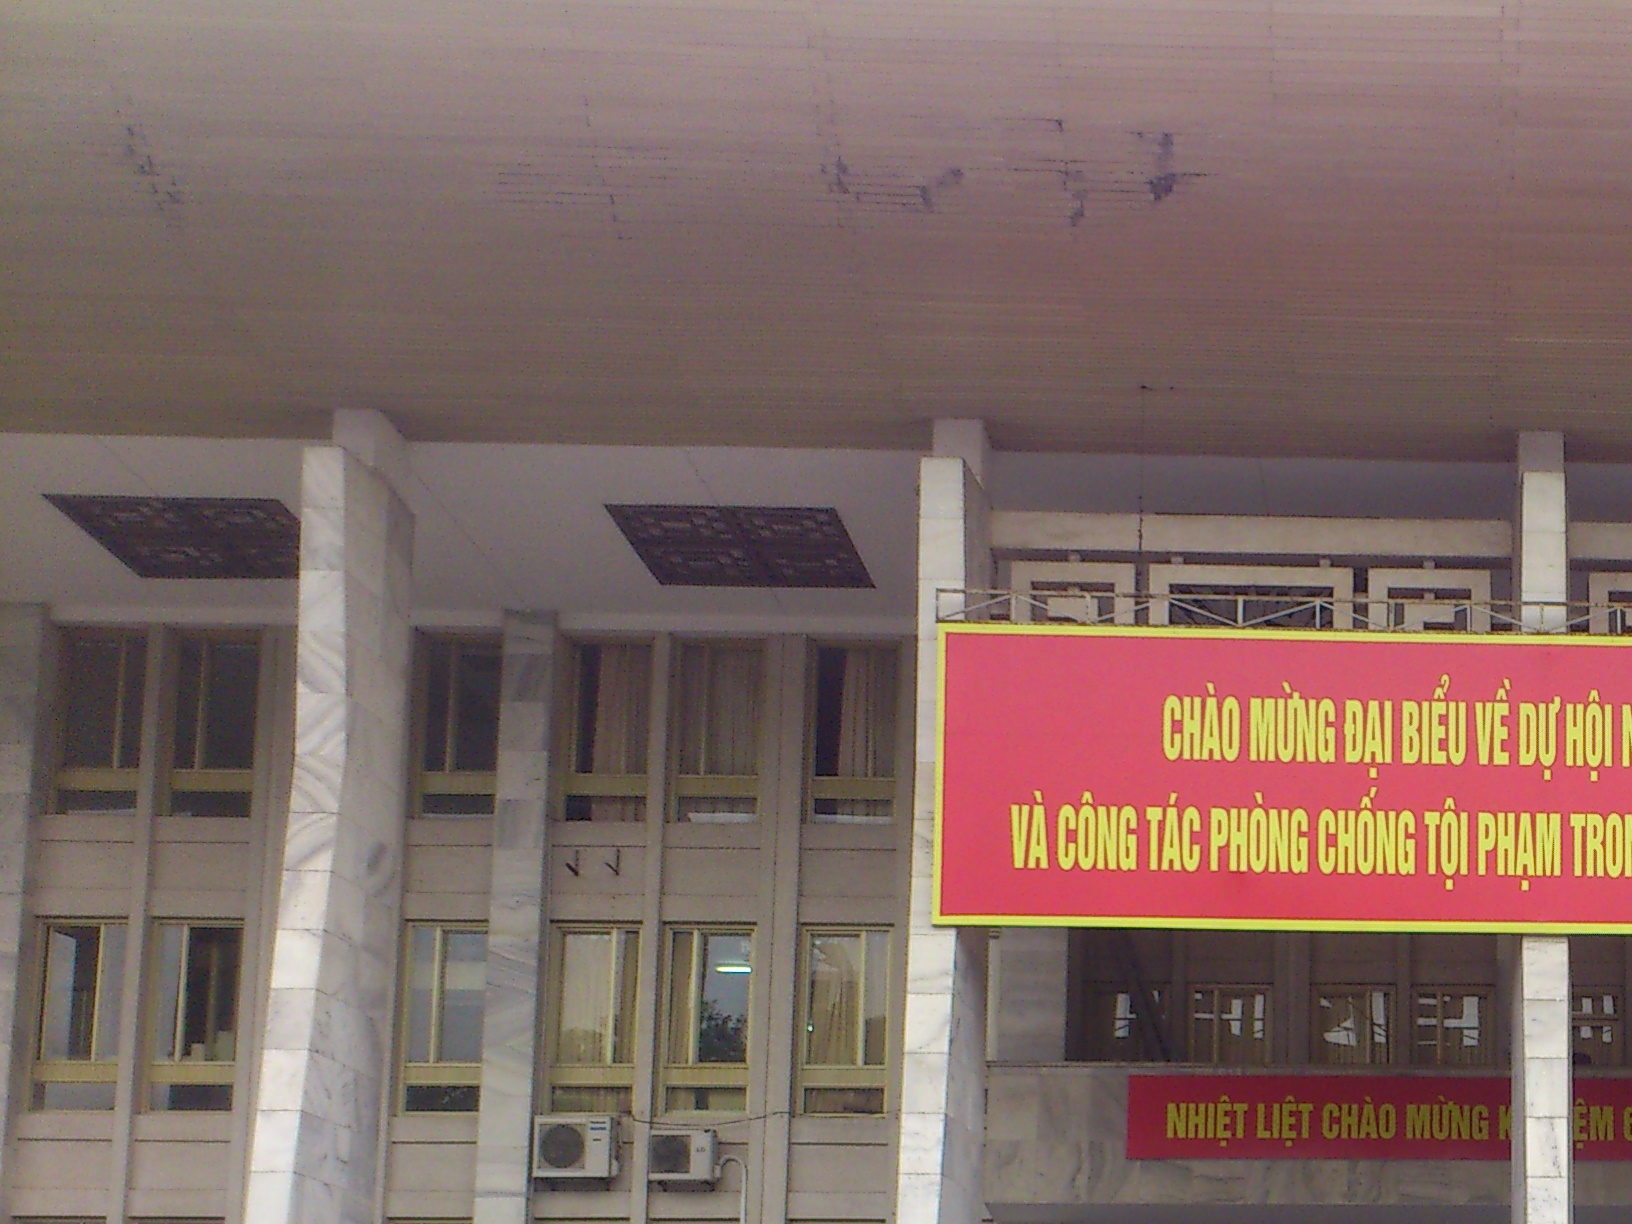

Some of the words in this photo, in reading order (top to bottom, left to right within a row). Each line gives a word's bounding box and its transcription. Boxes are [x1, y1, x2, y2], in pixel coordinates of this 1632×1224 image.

[1163, 682, 1240, 761] CHÀO
[1249, 681, 1336, 763] MỪNG
[1343, 699, 1392, 778] ĐẠI
[1401, 674, 1466, 765] BIỂU
[1475, 678, 1510, 765] VỀ
[1519, 696, 1561, 780] DỰ
[1564, 689, 1612, 782] HỘI
[1010, 790, 1048, 869] VÀ
[1057, 791, 1137, 871] CÔNG
[1146, 792, 1201, 872] TÁC
[1209, 792, 1309, 874] PHÒNG
[1318, 787, 1416, 875] CHỐNG
[1424, 797, 1468, 890] TỘI
[1478, 812, 1561, 891] PHẠM
[1167, 1096, 1248, 1146] NHIỆT
[1257, 1096, 1313, 1146] LIỆT
[1323, 1097, 1395, 1138] CHÀO
[1407, 1096, 1488, 1139] MỪNG
[1499, 1105, 1512, 1140] K
